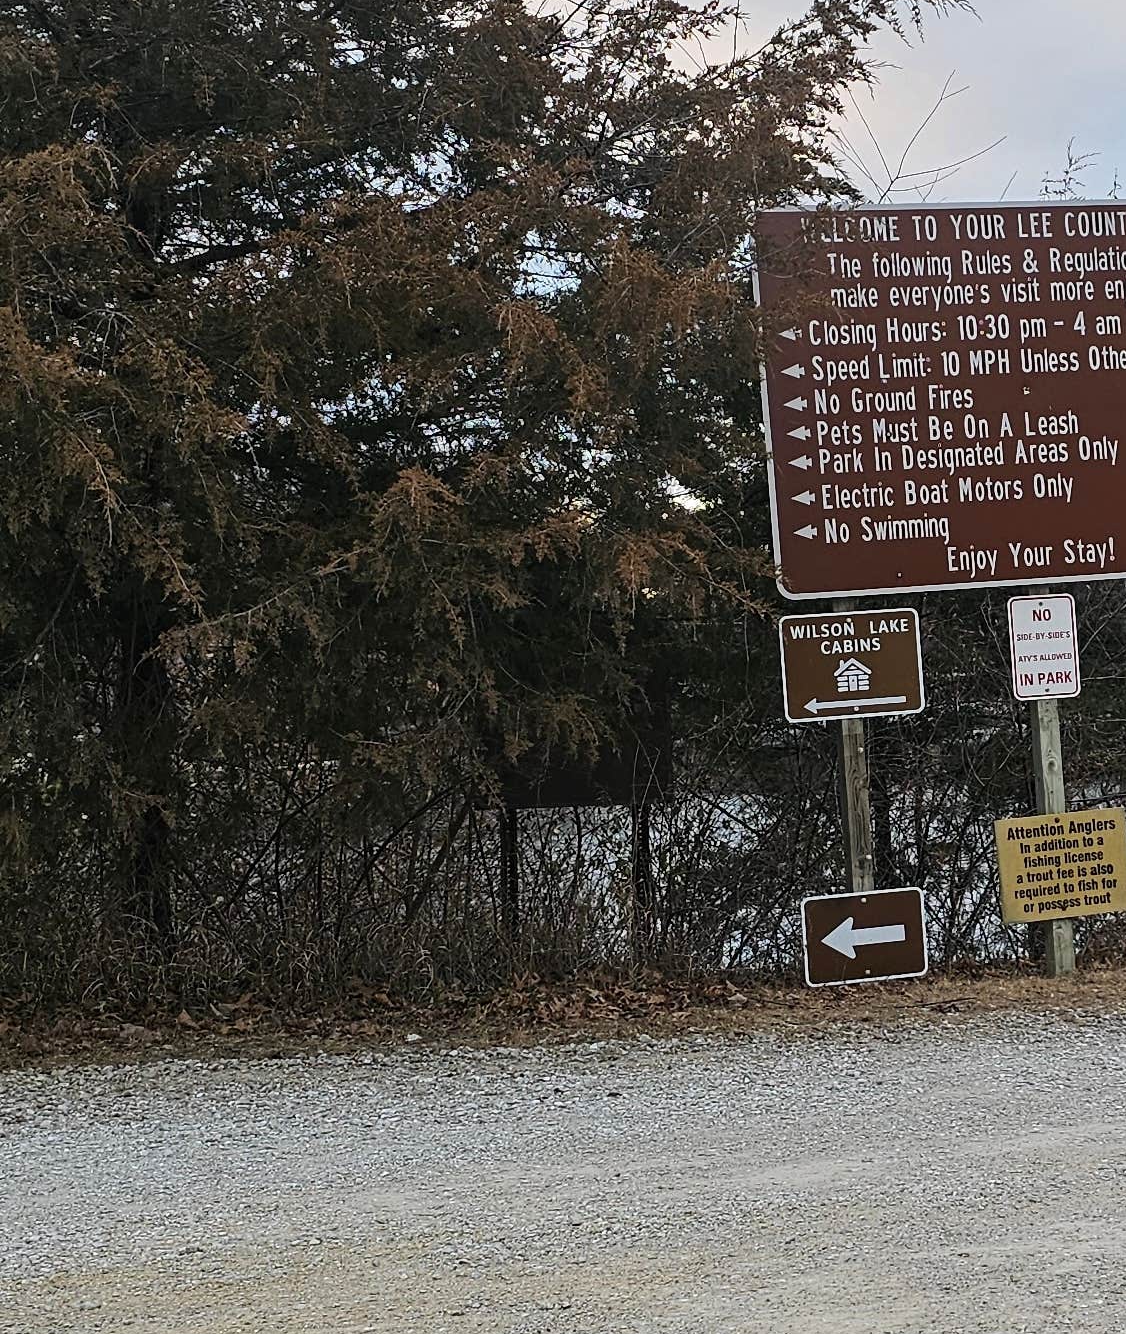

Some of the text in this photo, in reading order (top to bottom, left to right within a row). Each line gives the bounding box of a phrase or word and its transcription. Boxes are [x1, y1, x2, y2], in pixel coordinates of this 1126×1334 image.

[912, 215, 937, 241] TO
[950, 213, 1006, 240] YOUR
[1018, 212, 1053, 238] LEE
[827, 252, 861, 278] The
[872, 250, 952, 283] following
[962, 249, 1012, 275] Rules
[1022, 248, 1039, 273] &
[831, 283, 878, 308] make
[889, 281, 990, 312] everyone's
[1001, 277, 1040, 302] visit
[1050, 280, 1095, 301] more
[809, 319, 877, 352] Closing
[886, 318, 947, 343] Hours:
[957, 314, 1010, 341] 10:30
[1020, 317, 1047, 343] pm
[1073, 311, 1086, 335] 4
[1096, 315, 1122, 335] am
[811, 355, 870, 386] Speed
[878, 352, 932, 379] Limit:
[941, 352, 960, 376] 10
[969, 348, 1010, 375] MPH
[1020, 346, 1080, 373] Unless
[814, 384, 974, 415] No Ground Fires
[816, 410, 1079, 446] Pets Must Be On A Leash
[818, 435, 1119, 476] Park In Designated Areas Only
[821, 473, 1074, 510] Electric Boat Motors Only
[824, 513, 950, 545] No Swimming
[947, 536, 1116, 579] Enjoy Your Stay!
[1032, 608, 1052, 622] NO
[789, 618, 910, 639] WILSON LAKE
[820, 637, 881, 655] CABINS
[1040, 652, 1072, 661] ALLOWED
[1020, 670, 1073, 686] IN PARK
[1007, 818, 1116, 841] Attention Anglers
[1020, 836, 1104, 854] In addition to a
[1024, 850, 1104, 869] fishing license
[1016, 863, 1114, 884] a trout fee is also
[1014, 877, 1118, 900] required to fish for
[1023, 892, 1111, 914] or possess trout
